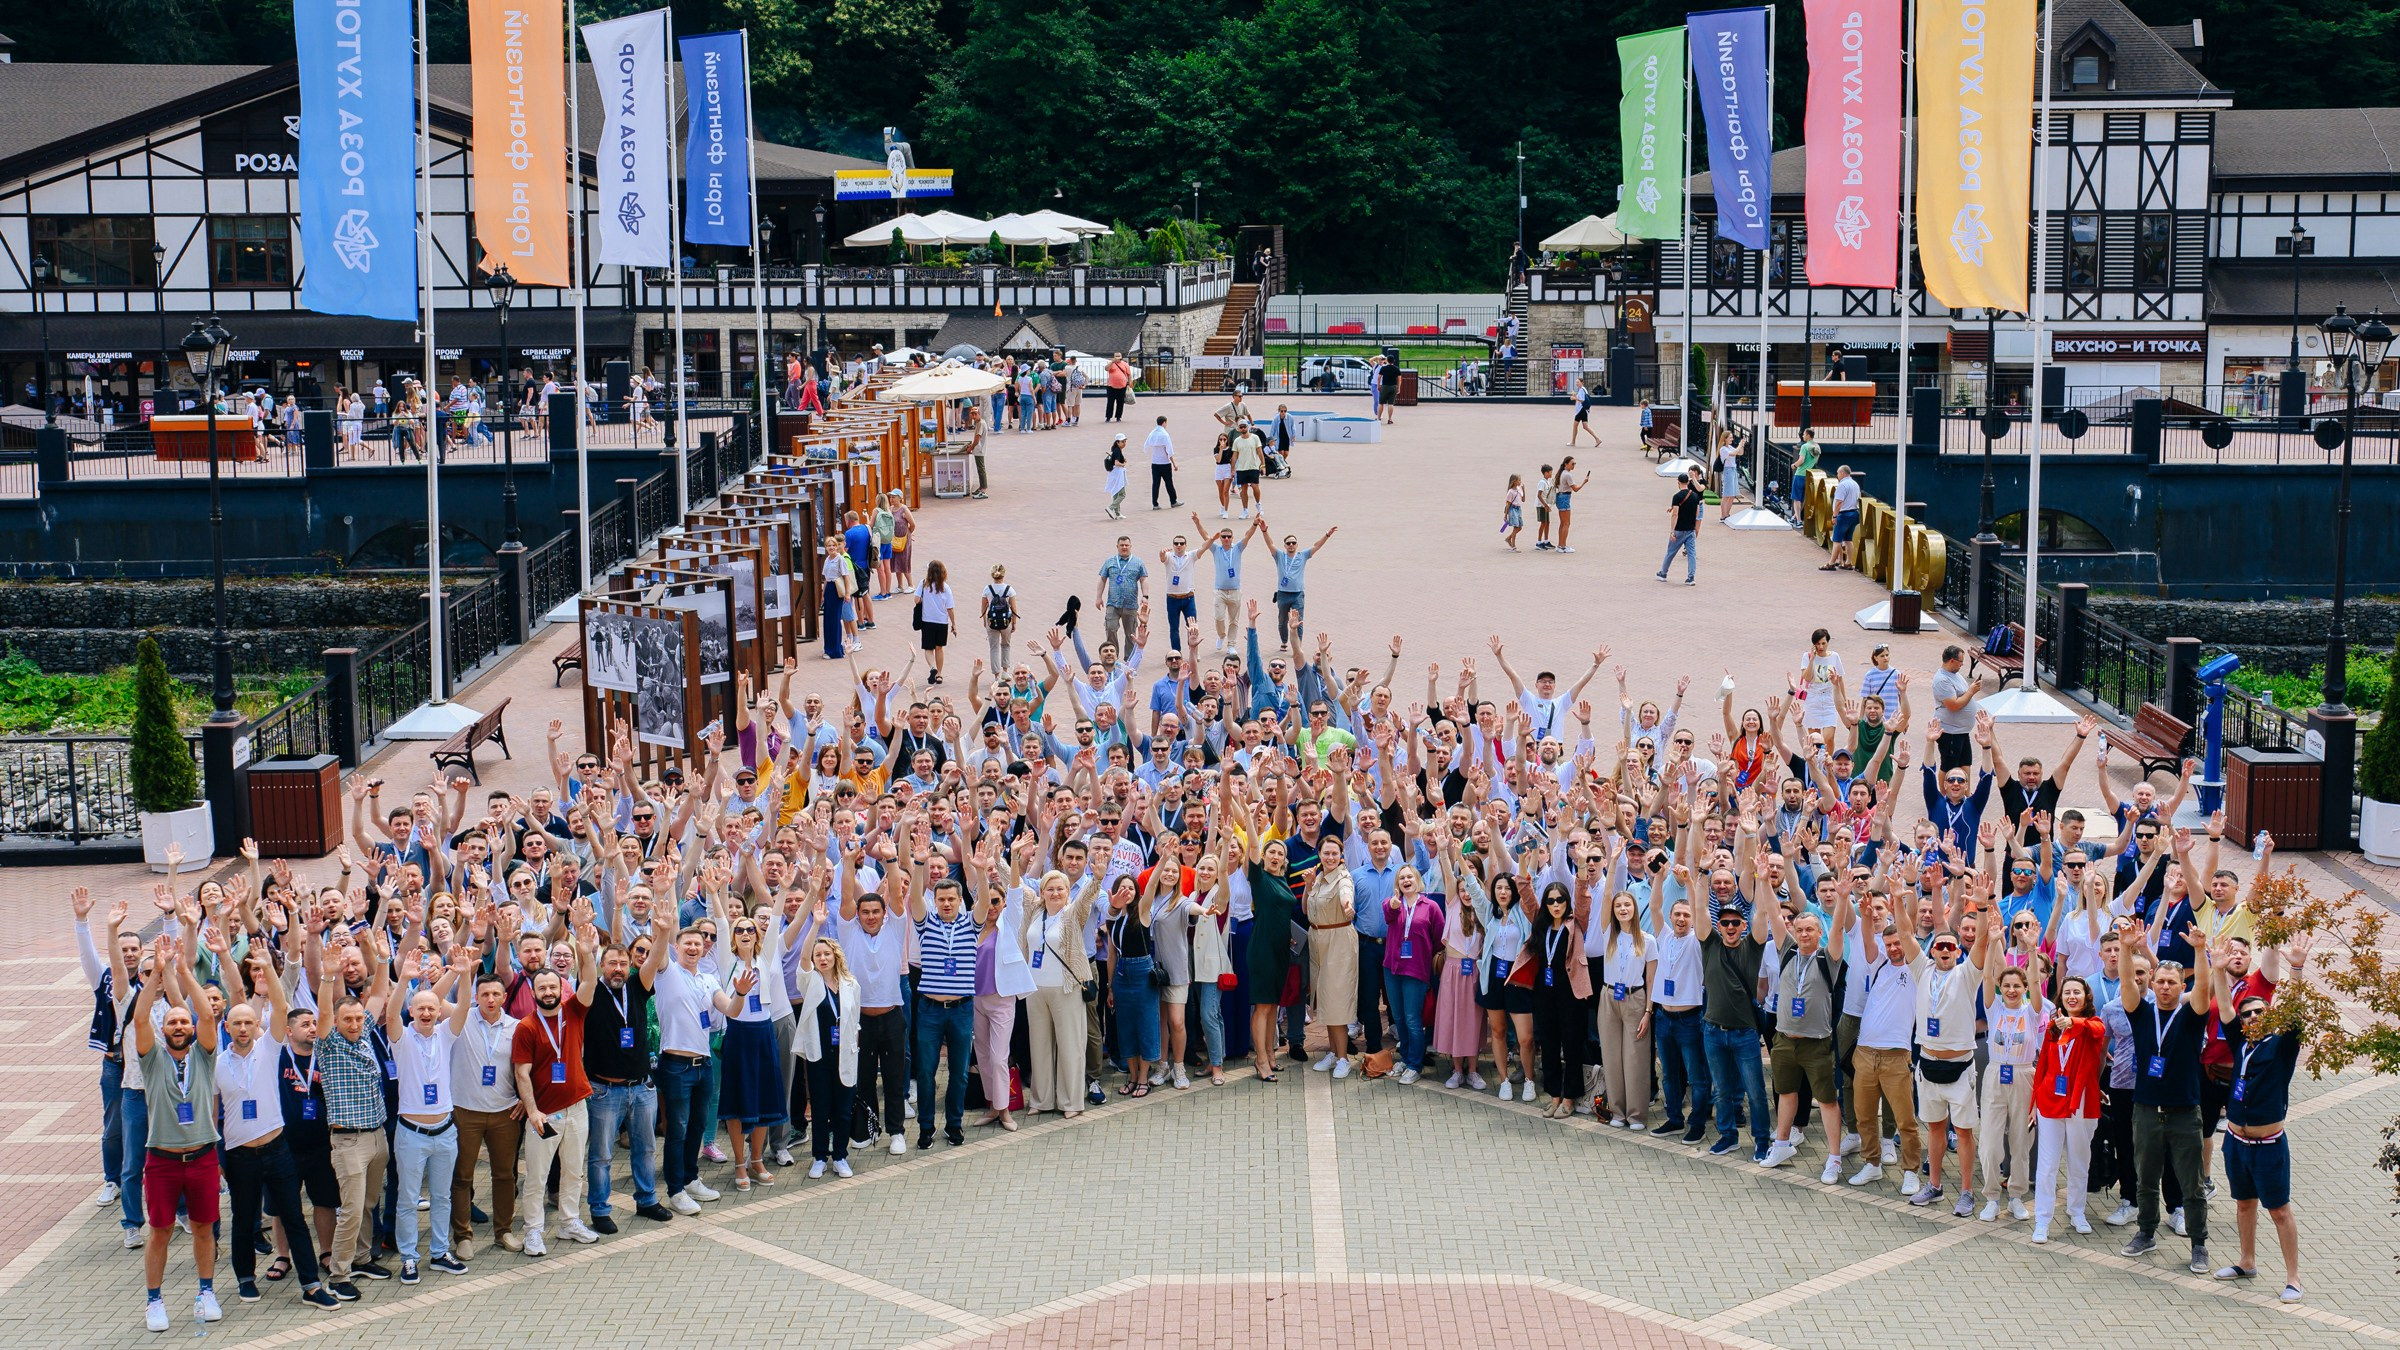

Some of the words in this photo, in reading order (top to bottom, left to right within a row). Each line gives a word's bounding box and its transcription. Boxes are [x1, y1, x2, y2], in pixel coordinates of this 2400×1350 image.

[235, 153, 298, 172] РОЗА
[1628, 307, 1642, 318] 24
[435, 348, 463, 356] ПРОКАТ
[548, 348, 571, 356] ЦЕНТР
[1735, 344, 1772, 352] TICKES
[2054, 340, 2117, 353] ВКУСНО
[2132, 340, 2145, 353] И
[2147, 340, 2202, 353] ТОЧКА
[1298, 420, 1305, 437] 1
[1342, 425, 1352, 439] 2
